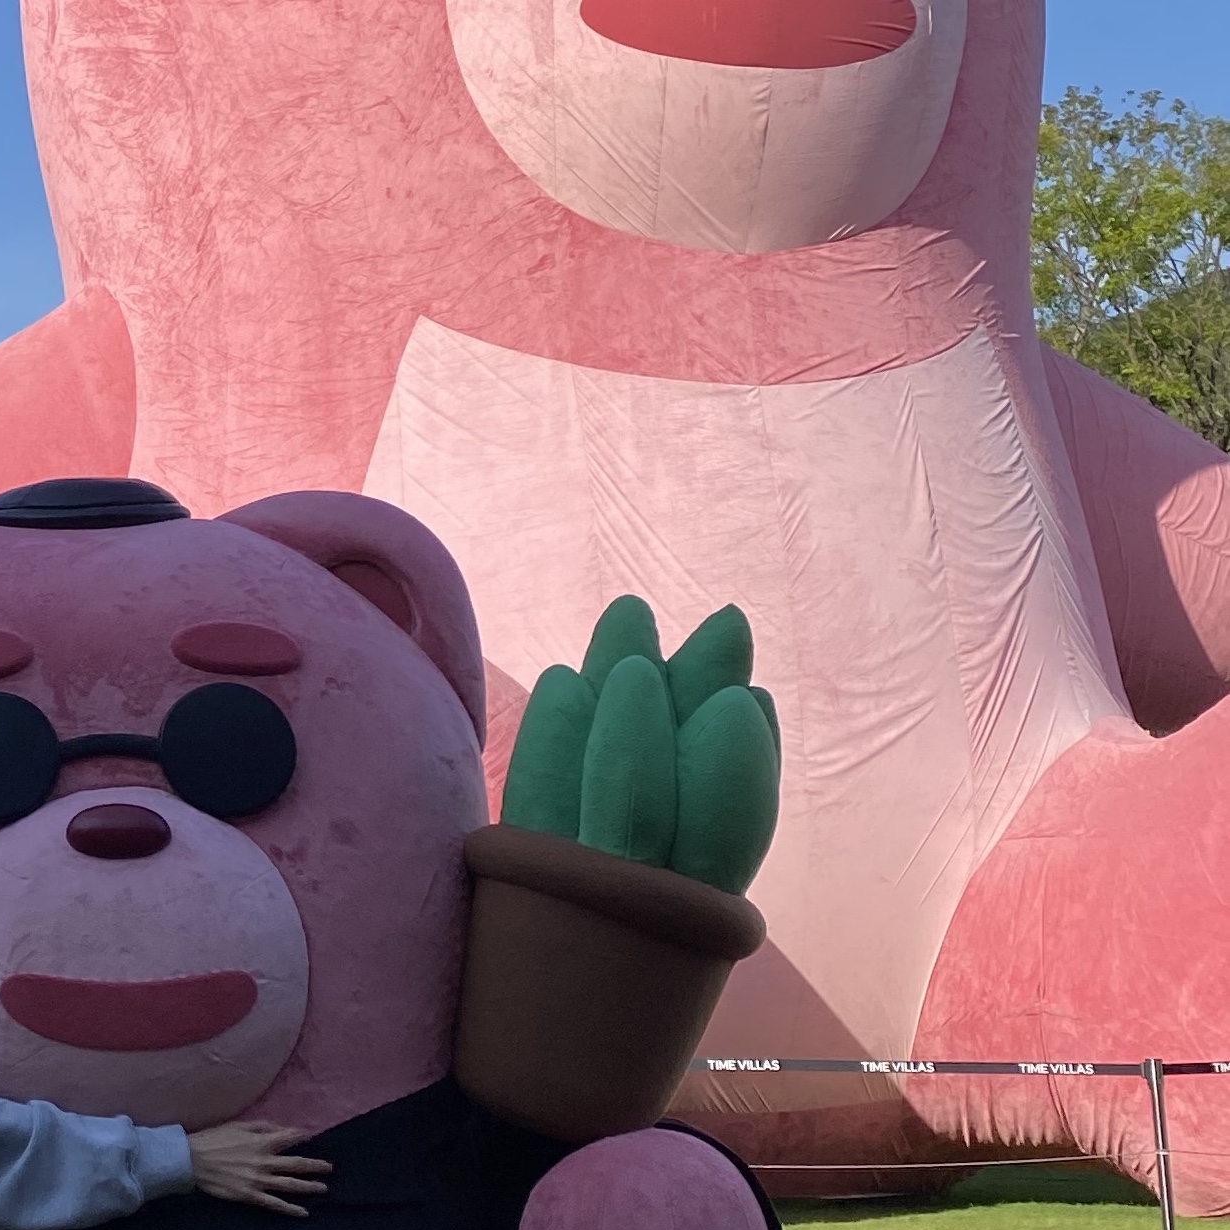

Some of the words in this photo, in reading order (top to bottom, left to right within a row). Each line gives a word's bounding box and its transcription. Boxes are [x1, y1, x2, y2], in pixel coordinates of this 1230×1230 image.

[707, 1059, 737, 1071] TIME
[737, 1059, 780, 1071] VILLAS
[861, 1061, 890, 1073] TIME
[892, 1061, 935, 1073] VILLAS
[1018, 1063, 1049, 1074] TIME
[1050, 1063, 1094, 1075] VILLAS
[1212, 1062, 1230, 1073] TIM
